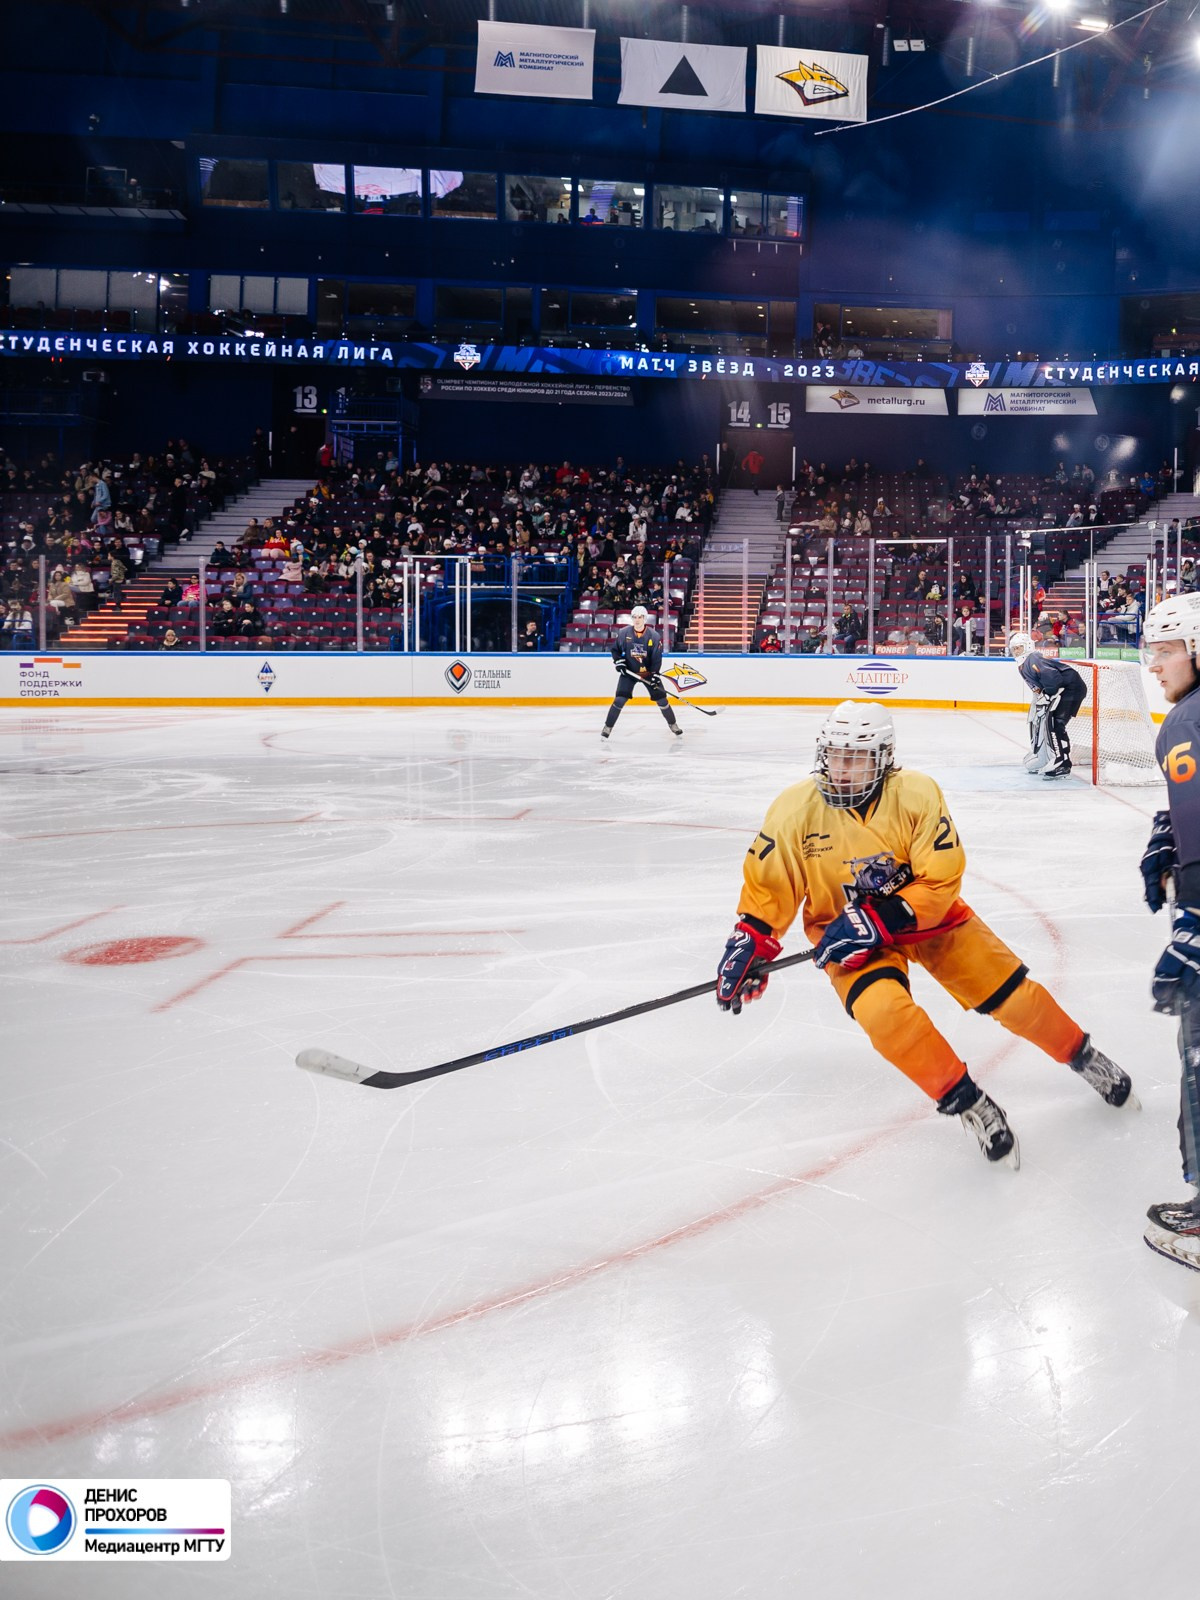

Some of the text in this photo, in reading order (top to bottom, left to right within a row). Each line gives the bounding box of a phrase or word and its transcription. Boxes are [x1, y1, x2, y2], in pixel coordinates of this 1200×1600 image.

[519, 51, 579, 60] МАГНИТОГОРСКИЙ
[519, 58, 585, 67] МЕТАЛЛУРГИЧЕСКИЙ
[188, 340, 325, 359] ХОККЕЙНАЯ
[338, 346, 393, 361] ЛИГА
[621, 357, 675, 371] МАТЧ
[688, 358, 755, 376] ЗВЁЗД
[784, 364, 835, 378] 2023
[1044, 362, 1199, 382] СТУДЕНЧЕСКАЯ
[293, 386, 317, 408] 13
[1009, 391, 1071, 399] МАГНИТОГОРСКИЙ
[867, 396, 926, 407] metallurg.ru
[728, 401, 750, 423] 14
[767, 402, 791, 424] 15
[875, 645, 908, 655] FONBET
[915, 647, 947, 655] FONBET
[19, 670, 50, 679] ФОНД
[473, 669, 512, 679] СТАЛЬНЫЕ
[846, 671, 909, 684] АДАПТЕР
[19, 680, 83, 688] ПОДДЕРЖКИ
[473, 679, 502, 690] СЕРДЦА
[1162, 741, 1197, 785] 6
[843, 903, 870, 937] UER
